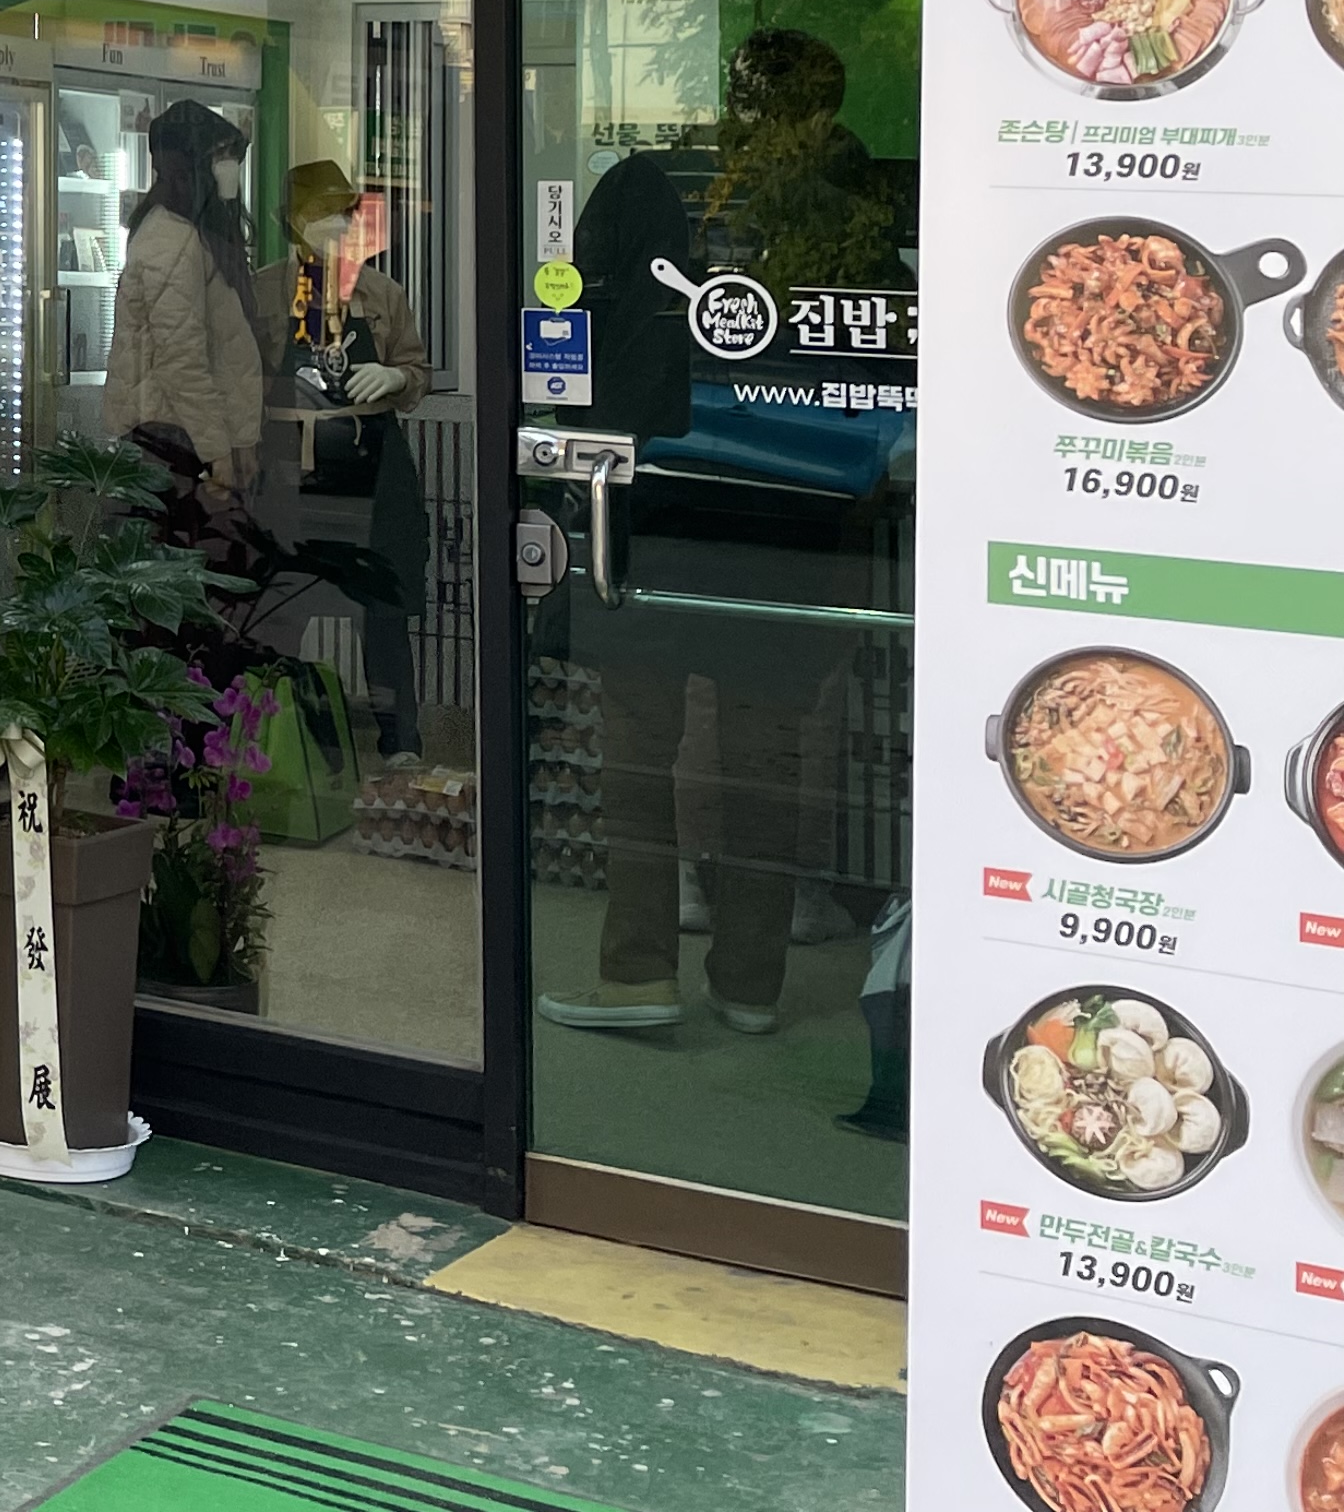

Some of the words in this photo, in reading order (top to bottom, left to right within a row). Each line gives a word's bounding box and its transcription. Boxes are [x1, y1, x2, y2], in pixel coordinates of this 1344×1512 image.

[102, 44, 124, 66] Fun
[200, 56, 226, 78] Trust
[998, 119, 1069, 143] 존슨탕
[1081, 125, 1157, 145] 프리미엄
[1160, 127, 1237, 147] 부대찌개
[1066, 151, 1201, 182] 13,900원
[547, 185, 563, 243] 당기시오
[708, 288, 759, 315] Fresh
[712, 329, 755, 346] Store
[1063, 466, 1200, 504] 16,900원
[1008, 553, 1130, 606] 신메뉴
[988, 875, 1022, 891] New
[1041, 877, 1164, 917] 시골청국장
[1059, 912, 1178, 955] 9,900원
[1305, 920, 1341, 939] New
[985, 1208, 1020, 1228] New
[1059, 1251, 1196, 1305] 13,900원
[1301, 1270, 1338, 1290] New
